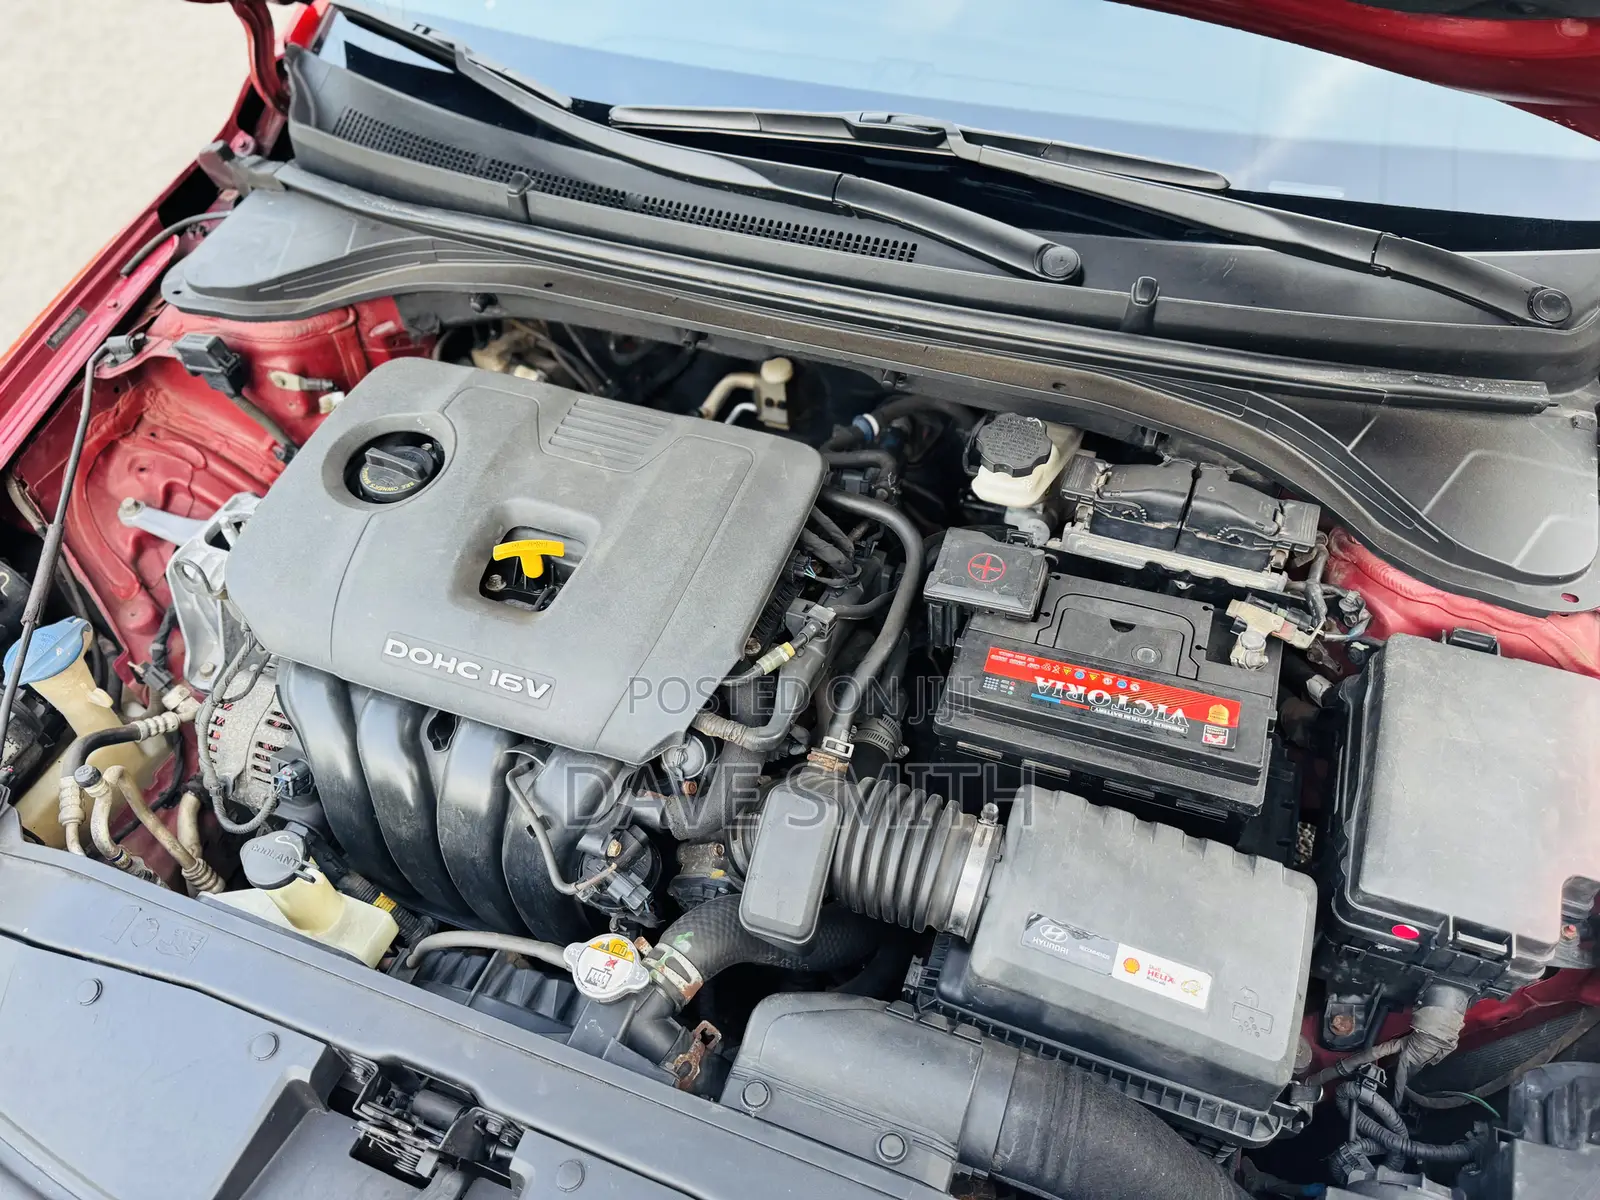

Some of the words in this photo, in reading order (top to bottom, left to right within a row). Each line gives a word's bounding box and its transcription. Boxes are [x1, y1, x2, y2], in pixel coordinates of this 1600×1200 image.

[383, 638, 483, 680] DOHC
[489, 669, 552, 700] 16V
[1034, 676, 1189, 727] VICTORIA
[251, 843, 300, 868] COOLANT
[1032, 936, 1069, 955] HYUNDAI
[1147, 969, 1174, 984] HELIX
